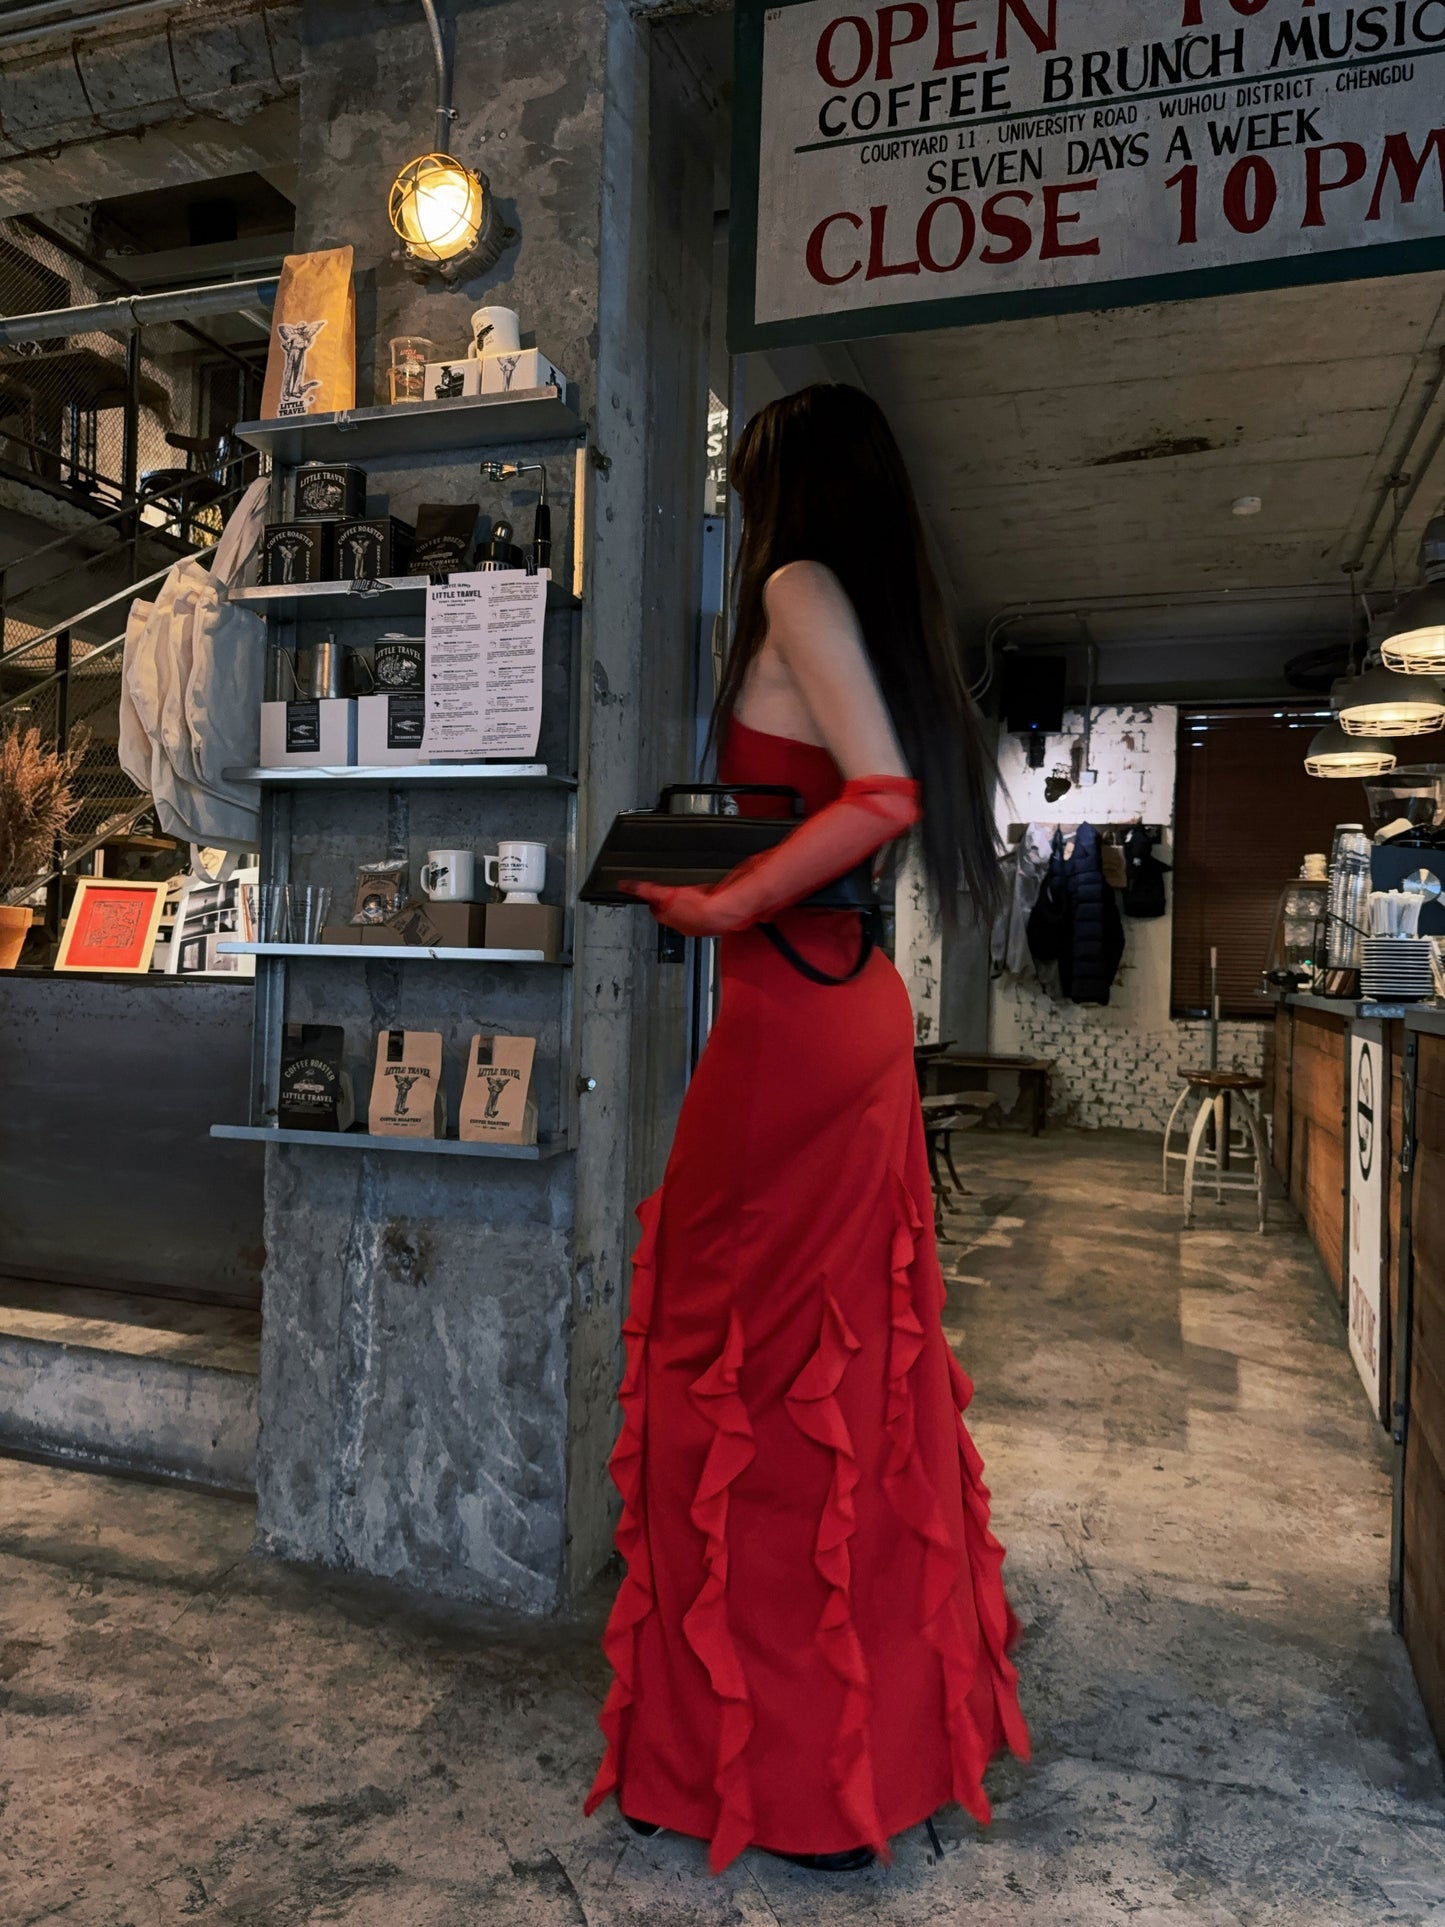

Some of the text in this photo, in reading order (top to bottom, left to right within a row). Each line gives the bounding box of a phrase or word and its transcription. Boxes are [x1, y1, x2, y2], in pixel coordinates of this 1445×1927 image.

[815, 0, 1058, 88] OPEN
[818, 0, 1445, 137] COFFEE BRUNCH MUSIC
[860, 63, 1414, 164] COURTYARD 11 UNIVERSITY ROAD WUHOU DISTRICT CHENGDU
[925, 107, 1324, 195] SEVEN DAYS A WEEK
[806, 178, 1100, 286] CLOSE
[279, 407, 306, 417] TRAVEL
[280, 401, 304, 410] LITTLE
[300, 472, 346, 488] LITTLE TRAVEL
[267, 531, 314, 550] COFFEE ROASTER
[337, 525, 385, 545] COFFEE ROASTER
[432, 590, 482, 600] LITTLE TRAVEL
[375, 646, 422, 661] LITTLE TRAVEL
[284, 1059, 336, 1081] COFFEE ROASTER
[384, 1067, 431, 1078] LITTLE TRAVEL
[477, 1068, 521, 1080] LITTLE TRAVEL
[282, 1092, 333, 1103] LITTLE TRAVEL
